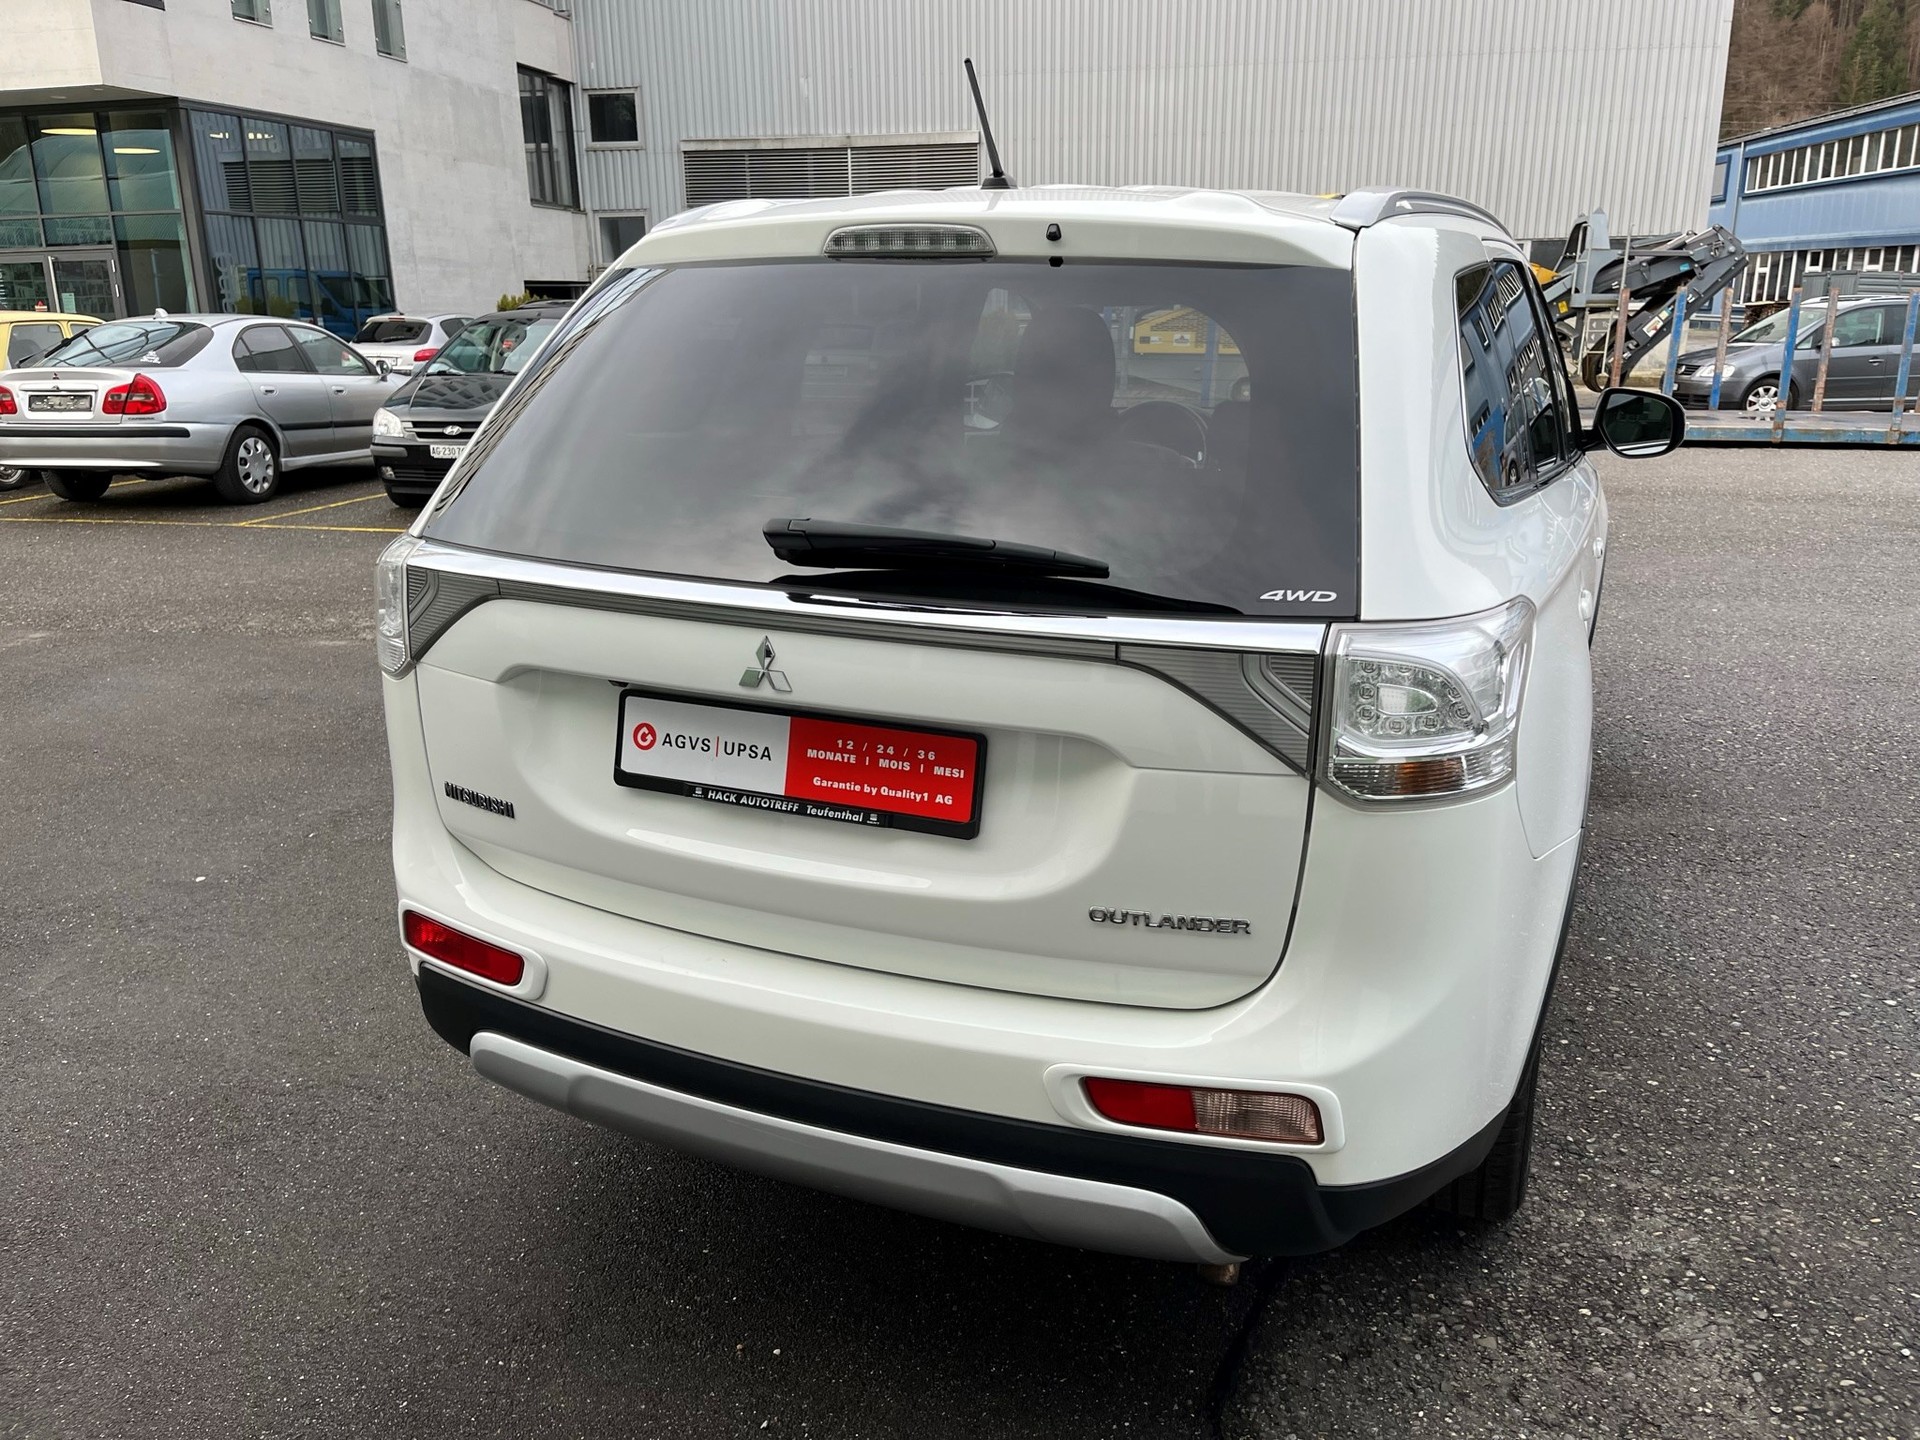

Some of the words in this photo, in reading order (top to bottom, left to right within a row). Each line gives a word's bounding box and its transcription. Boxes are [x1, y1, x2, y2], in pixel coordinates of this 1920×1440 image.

[1259, 589, 1338, 603] 4WD
[662, 733, 711, 752] AGVS
[723, 741, 772, 761] UPSA
[837, 739, 854, 750] 12
[876, 744, 894, 755] 24
[917, 750, 936, 761] 36
[806, 749, 857, 764] MONATE
[878, 758, 911, 771] MOIS
[933, 766, 965, 779] MESI
[812, 776, 861, 792] Garantie
[863, 784, 878, 796] by
[880, 786, 929, 802] Quality1
[935, 794, 953, 805] AG
[707, 789, 738, 803] HACK
[739, 795, 799, 812] AUTOTREFF
[806, 804, 864, 822] Teufenthal
[1088, 905, 1251, 934] OUTLANDER
